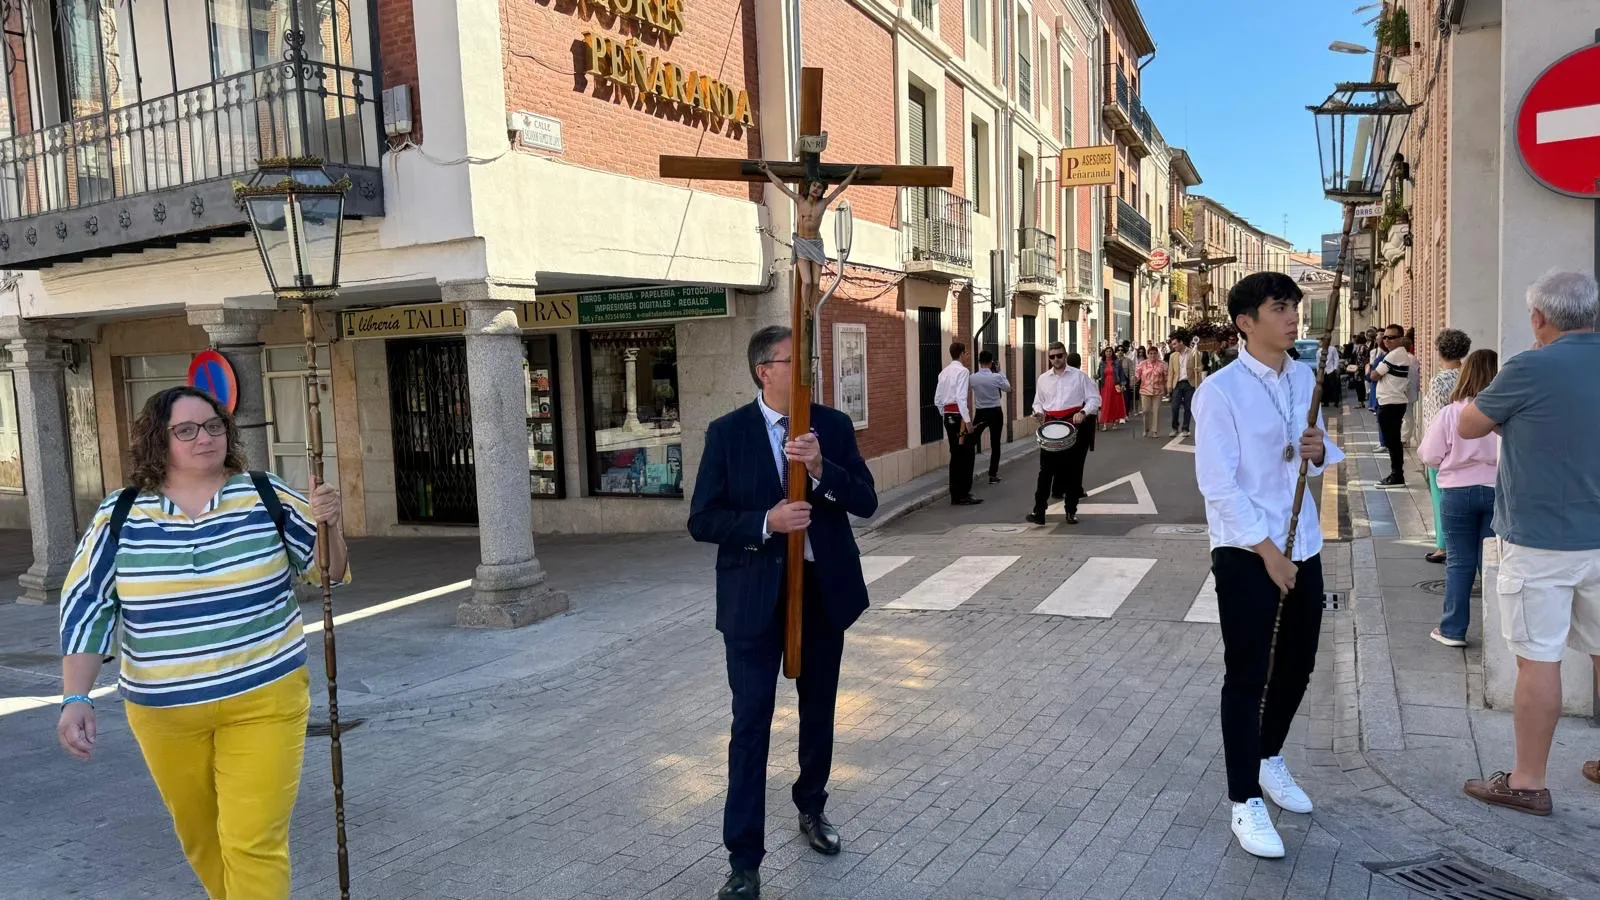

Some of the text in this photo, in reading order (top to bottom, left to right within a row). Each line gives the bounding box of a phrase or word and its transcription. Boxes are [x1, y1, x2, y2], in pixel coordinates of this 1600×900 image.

[583, 32, 754, 127] PEÑARANDA
[534, 120, 551, 132] CALLE
[1067, 157, 1111, 179] Peñaranda
[1082, 153, 1111, 166] ASESORES
[580, 294, 602, 304] LIBROS
[608, 292, 634, 302] PRENSA
[682, 286, 724, 296] FOTOCOPIAS
[594, 297, 709, 312] IMPRESIONES DIGITALES REGALOS
[358, 314, 400, 332] librería
[520, 299, 572, 323] TRAS
